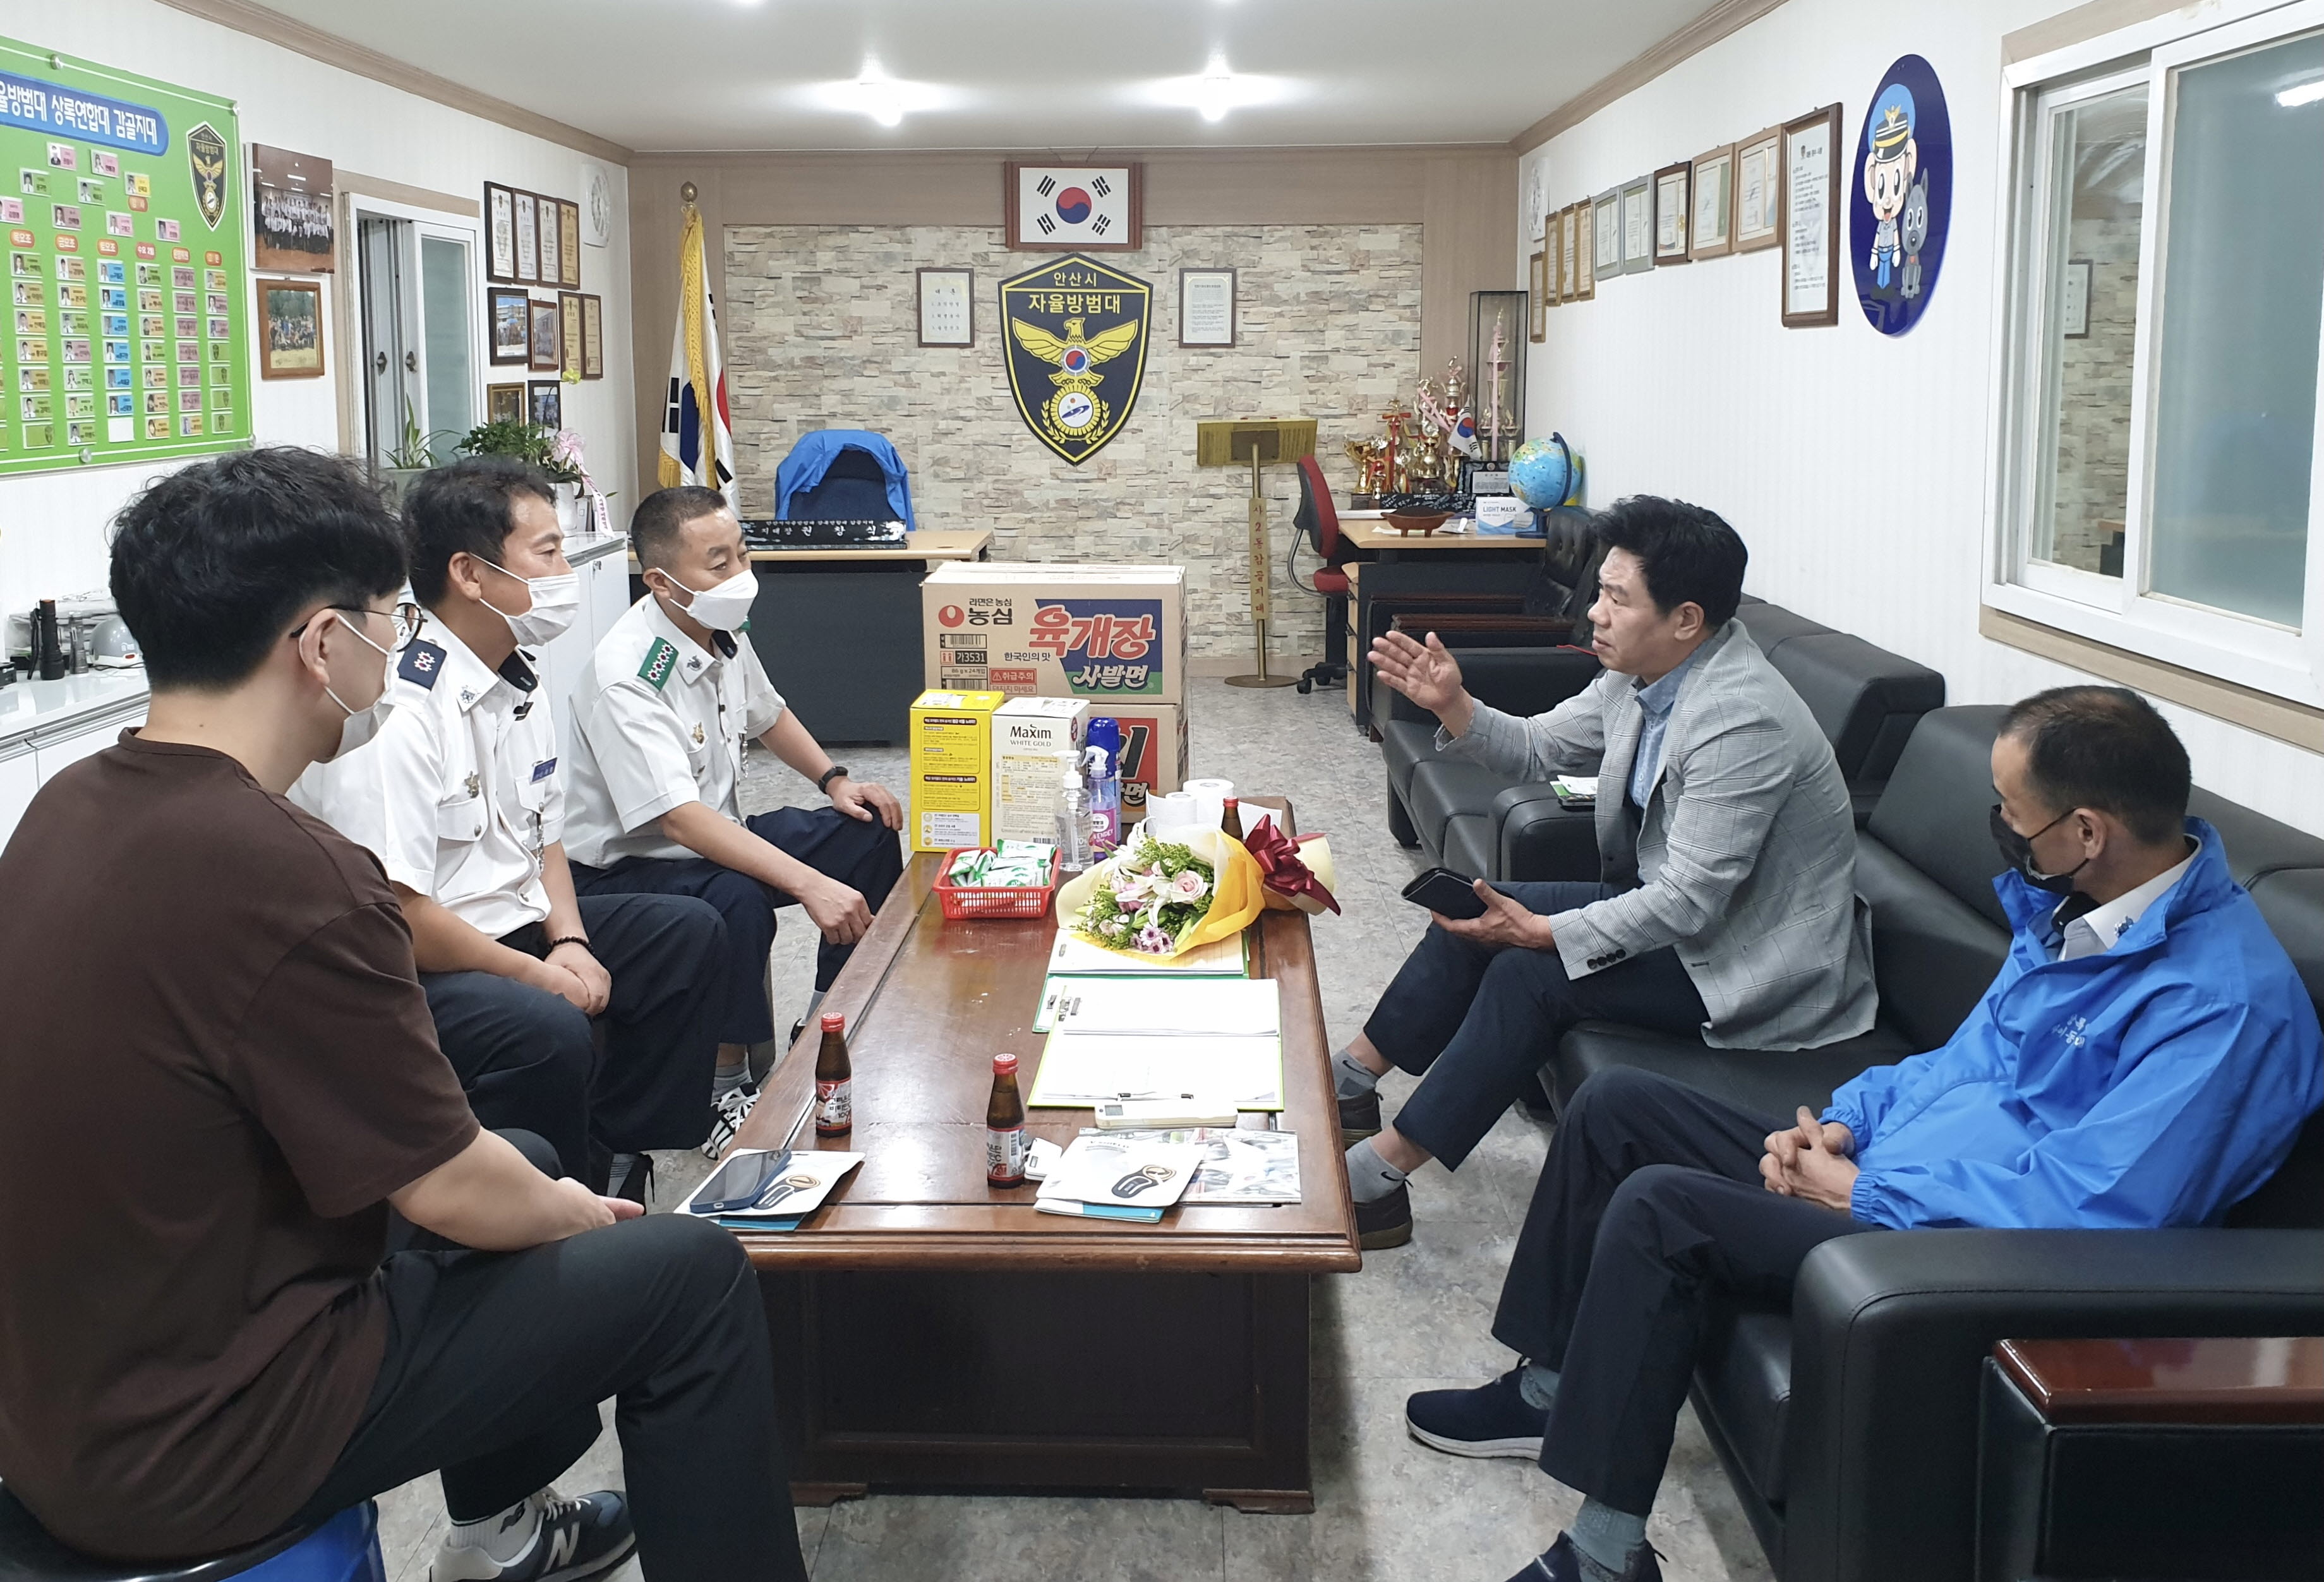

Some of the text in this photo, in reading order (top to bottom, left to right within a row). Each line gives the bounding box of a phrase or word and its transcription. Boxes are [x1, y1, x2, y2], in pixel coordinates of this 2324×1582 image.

[51, 95, 111, 135] 상록연합대
[113, 109, 157, 145] 감골지대
[1054, 272, 1097, 287] 안산시
[1028, 294, 1121, 314] 자율방범대
[969, 598, 1012, 606] 라면은 농심
[968, 608, 1013, 626] 농심
[1028, 606, 1154, 659] 육개장
[957, 652, 985, 662] 가3531
[1004, 652, 1051, 662] 한국인의 맛
[1002, 672, 1033, 681] 취급주의
[1010, 724, 1051, 739] Maxim
